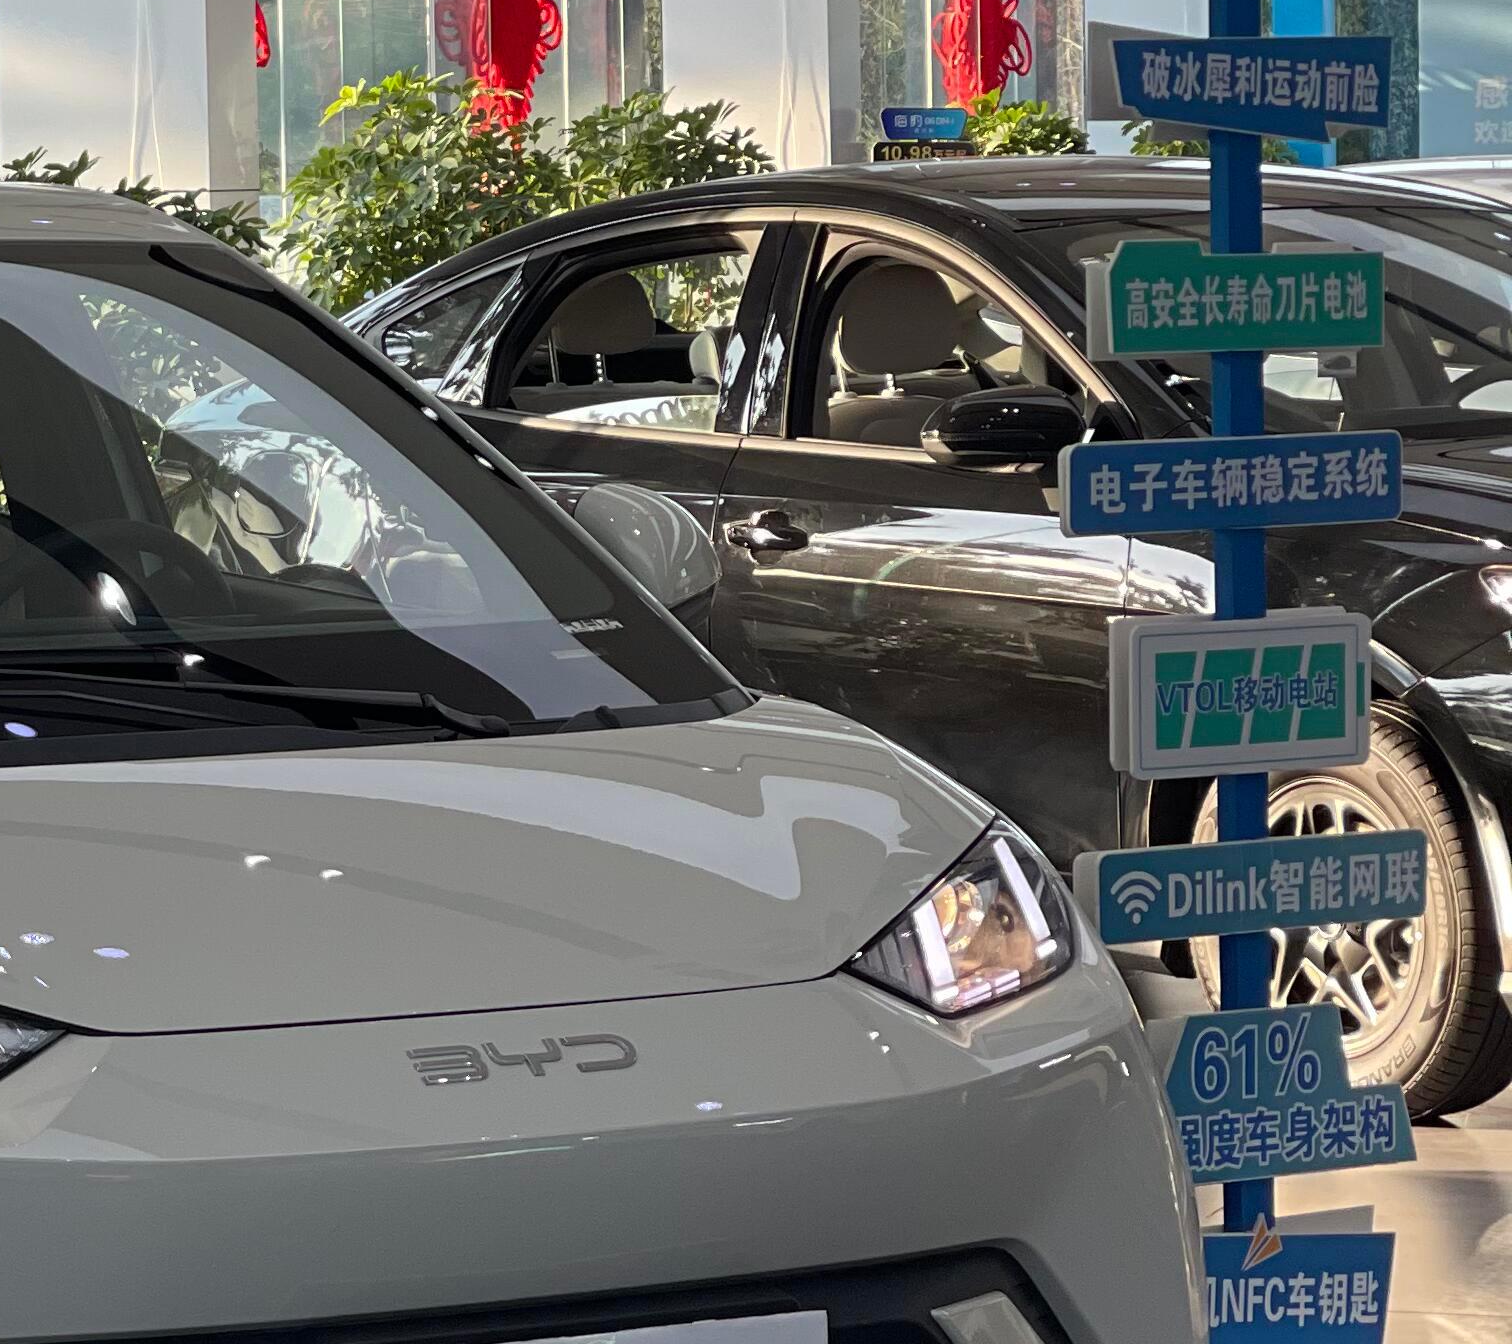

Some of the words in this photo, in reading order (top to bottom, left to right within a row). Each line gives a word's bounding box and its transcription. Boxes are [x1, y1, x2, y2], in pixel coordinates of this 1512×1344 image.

[1141, 47, 1380, 113] 破冰犀利运动前脸
[1124, 270, 1369, 330] 高安全长寿命刀片电池
[1089, 446, 1390, 515] 电子车辆稳定系统
[1155, 670, 1339, 715] VTOL移动电站
[1167, 849, 1421, 919] Dilink智能网联
[405, 1033, 638, 1087] BYD
[1190, 1011, 1323, 1104] 61%
